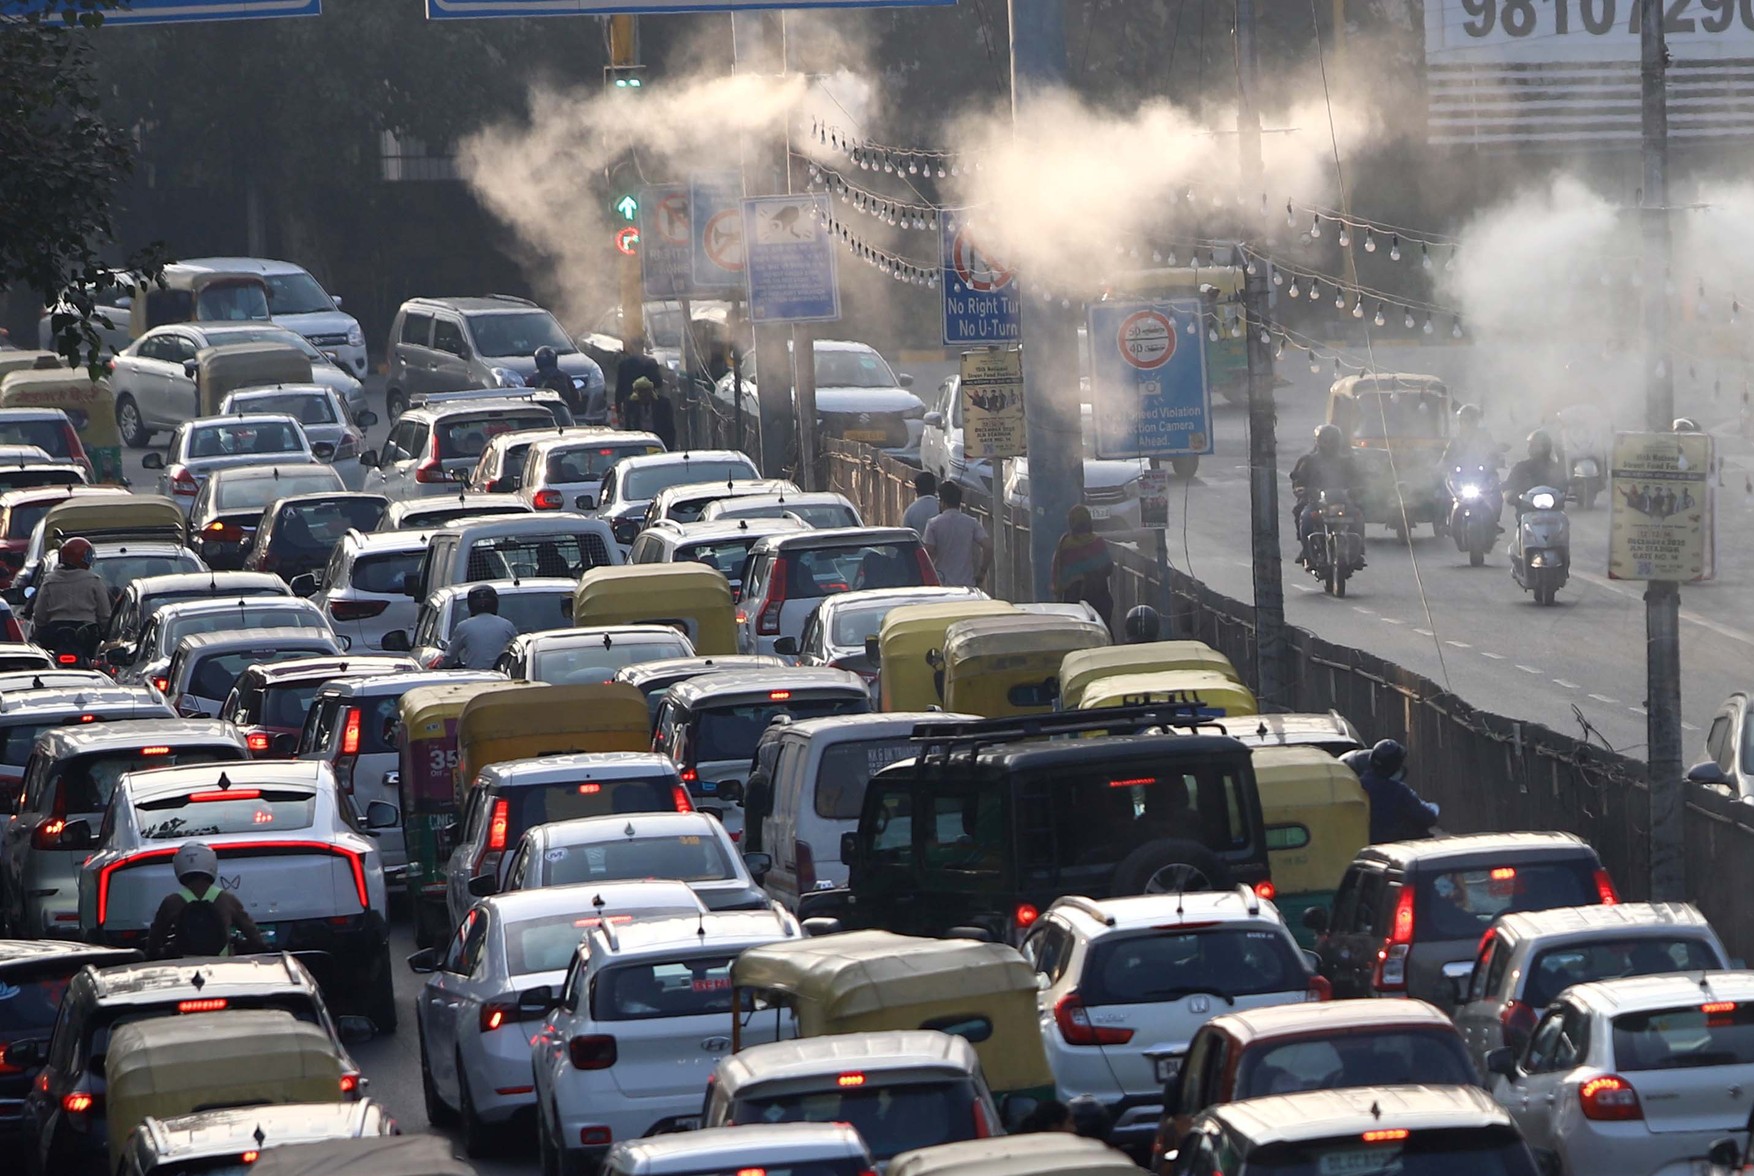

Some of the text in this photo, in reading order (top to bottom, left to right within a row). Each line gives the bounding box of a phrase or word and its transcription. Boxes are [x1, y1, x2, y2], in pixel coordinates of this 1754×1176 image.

[947, 297, 1020, 317] No Right Tur
[959, 319, 1019, 337] No U-Turn
[1159, 406, 1201, 418] Violation
[1159, 420, 1195, 432] Camera
